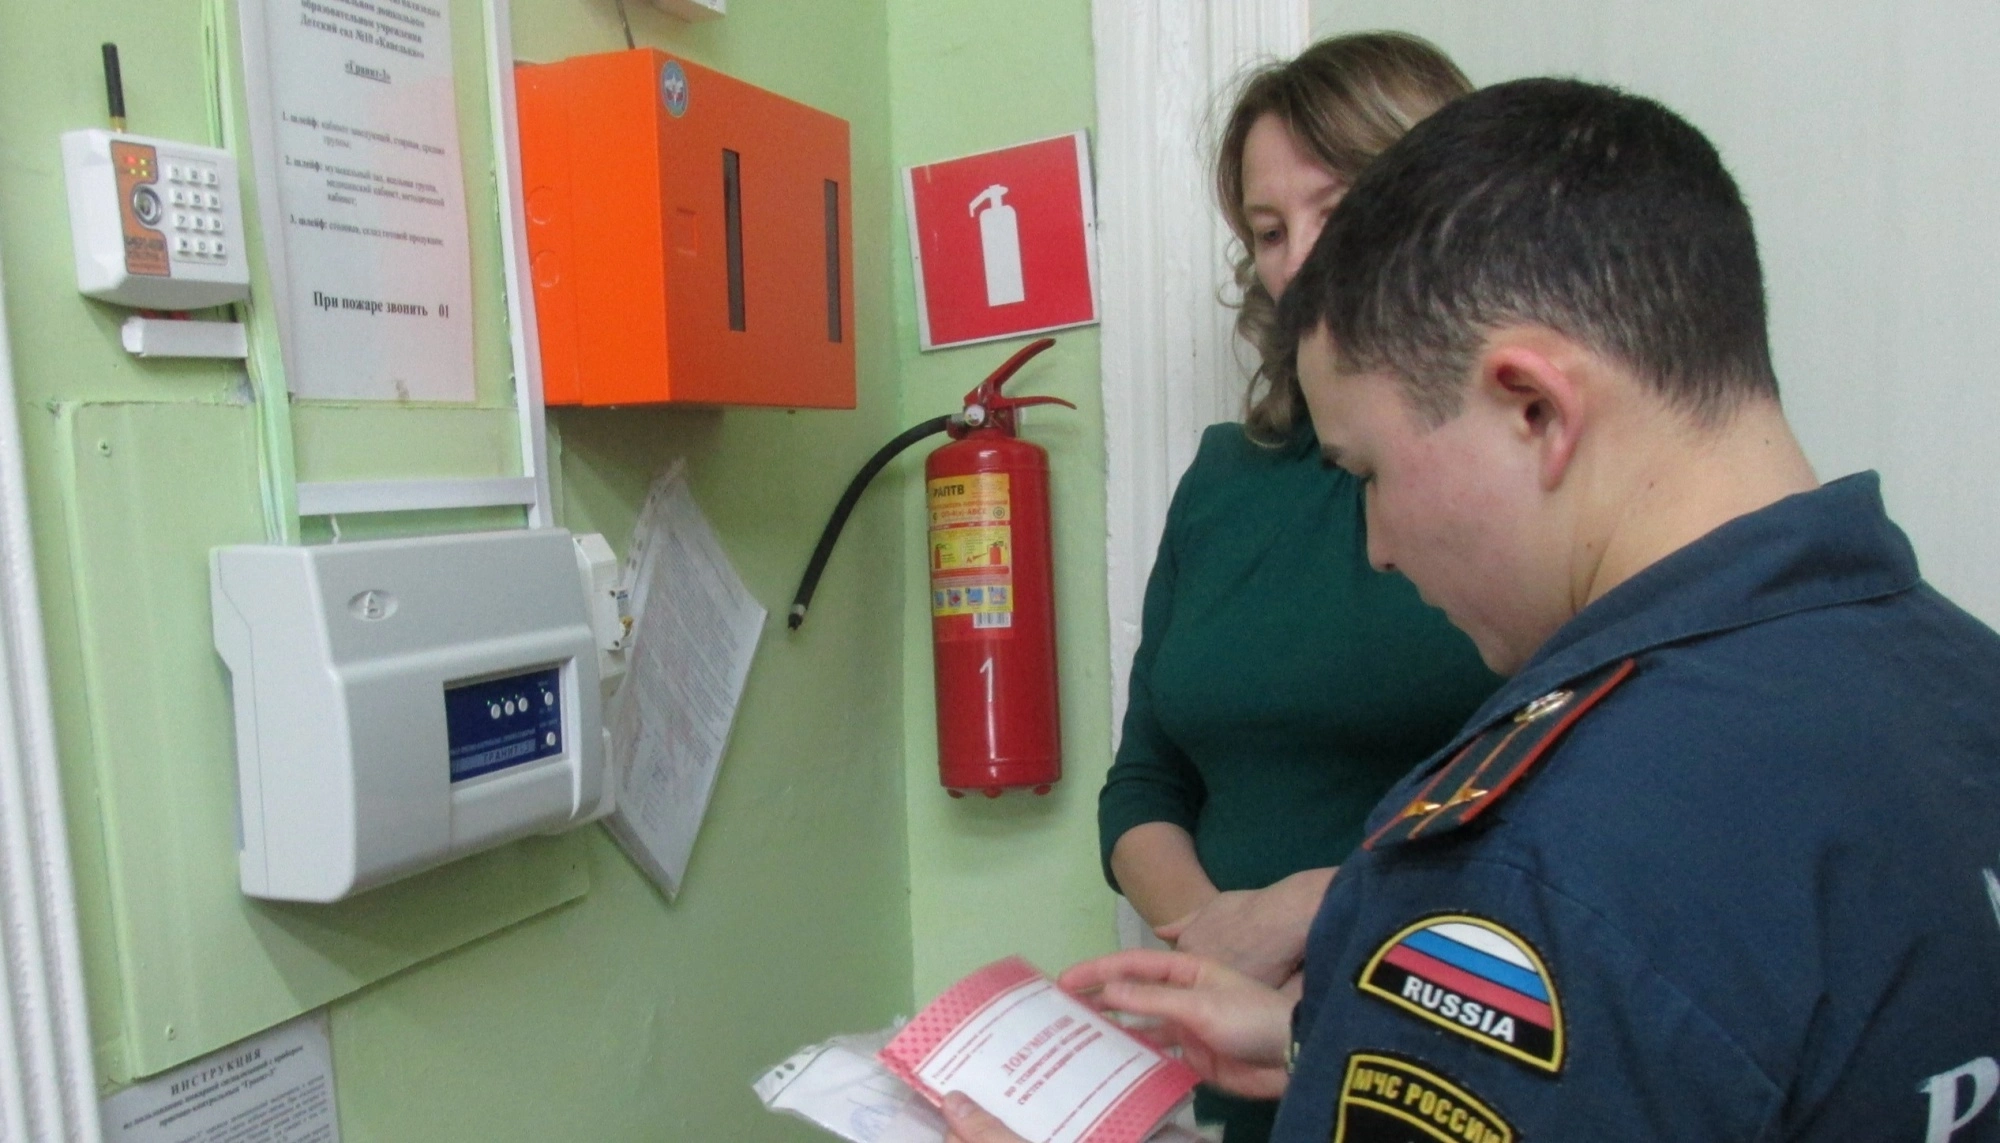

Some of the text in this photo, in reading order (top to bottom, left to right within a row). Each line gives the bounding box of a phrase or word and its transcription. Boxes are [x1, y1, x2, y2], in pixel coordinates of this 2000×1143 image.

[313, 291, 449, 318] При пожаре звонить 01
[1402, 976, 1515, 1043] RUSSIA
[171, 1048, 261, 1096] ИНСТРУКЦИЯ
[1351, 1068, 1502, 1143] МЧС РОССИИ
